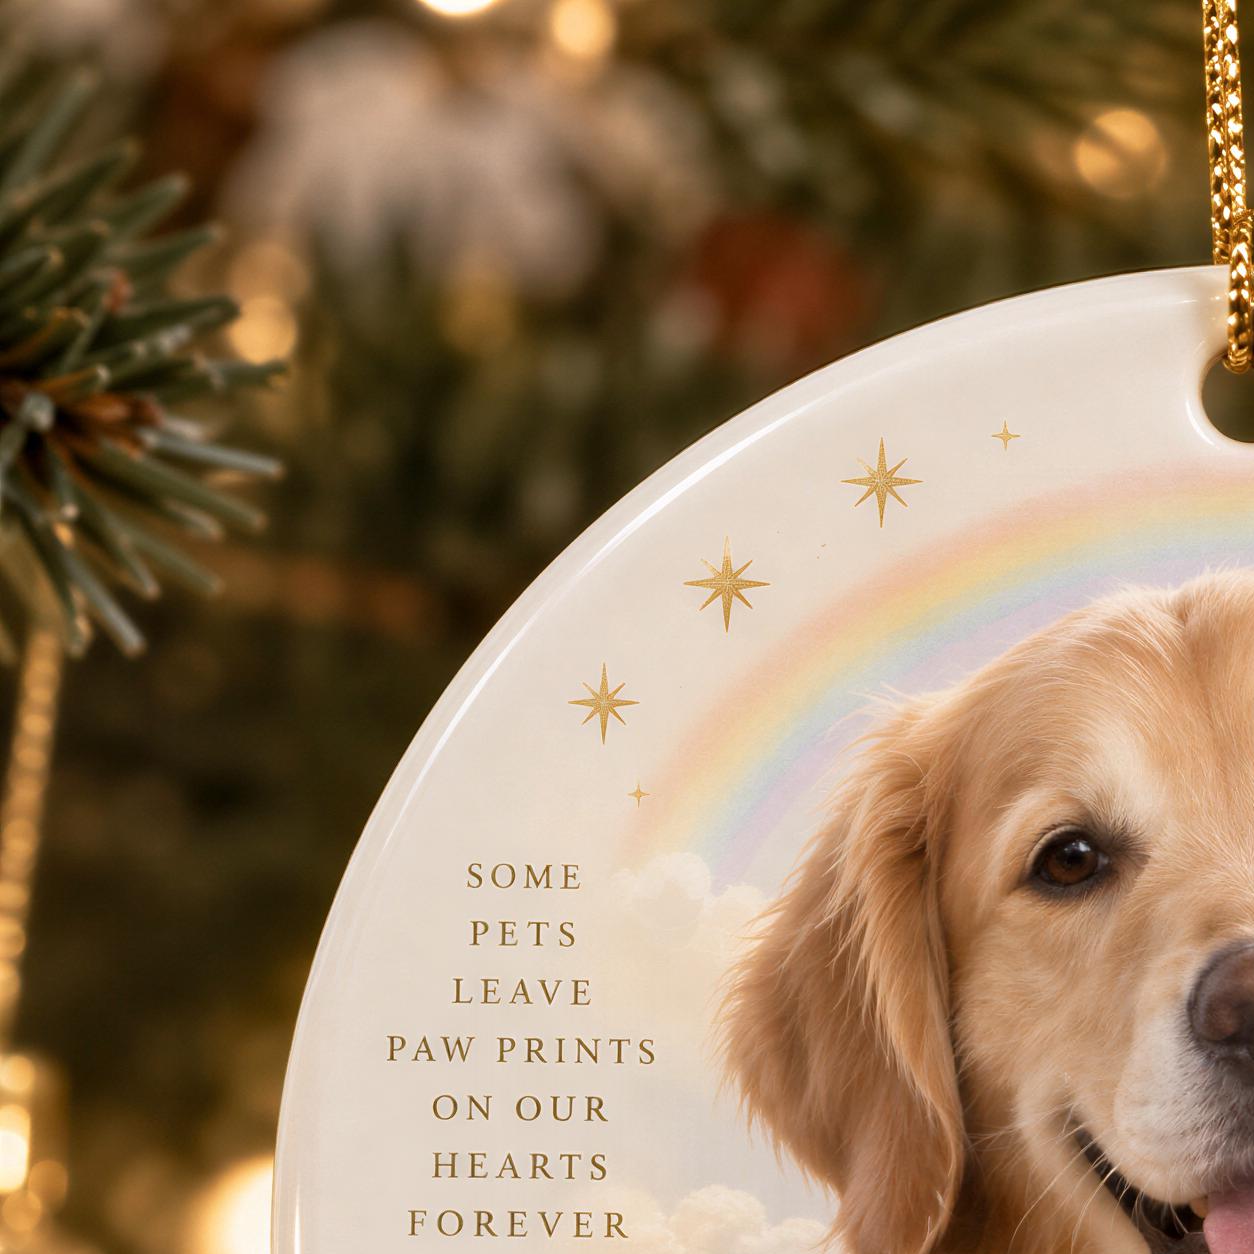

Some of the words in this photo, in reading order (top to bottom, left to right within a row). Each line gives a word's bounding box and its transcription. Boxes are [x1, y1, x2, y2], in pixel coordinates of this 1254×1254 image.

[467, 862, 581, 890] SOME
[469, 920, 576, 948] PETS
[451, 978, 593, 1006] LEAVE
[386, 1035, 476, 1063] PAW
[496, 1037, 656, 1065] PRINTS
[432, 1094, 493, 1121] ON
[515, 1095, 609, 1122] OUR
[431, 1152, 608, 1181] HEARTS
[407, 1209, 629, 1239] FOREVER
